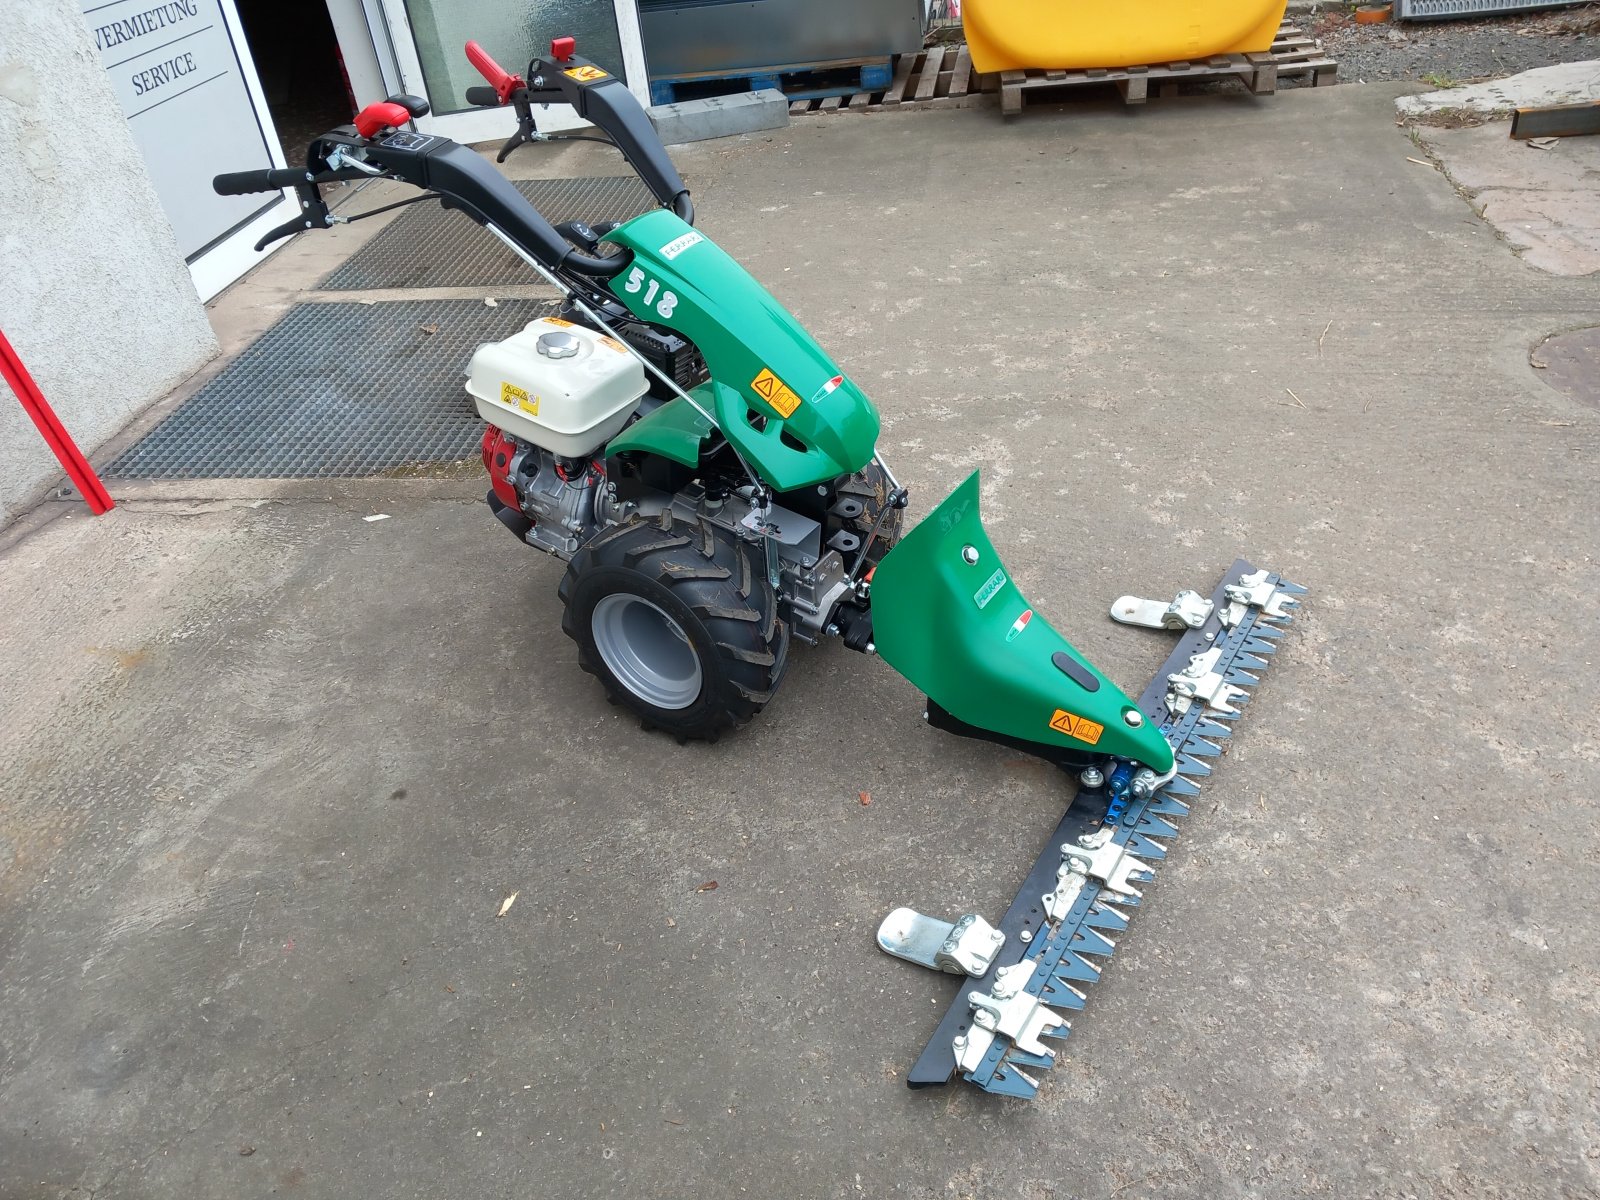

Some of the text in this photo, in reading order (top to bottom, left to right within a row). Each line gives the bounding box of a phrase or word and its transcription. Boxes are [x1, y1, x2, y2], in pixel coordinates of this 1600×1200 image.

[94, 0, 198, 51] VERMIETUNG
[131, 52, 197, 96] SERVICE
[624, 266, 679, 319] 518
